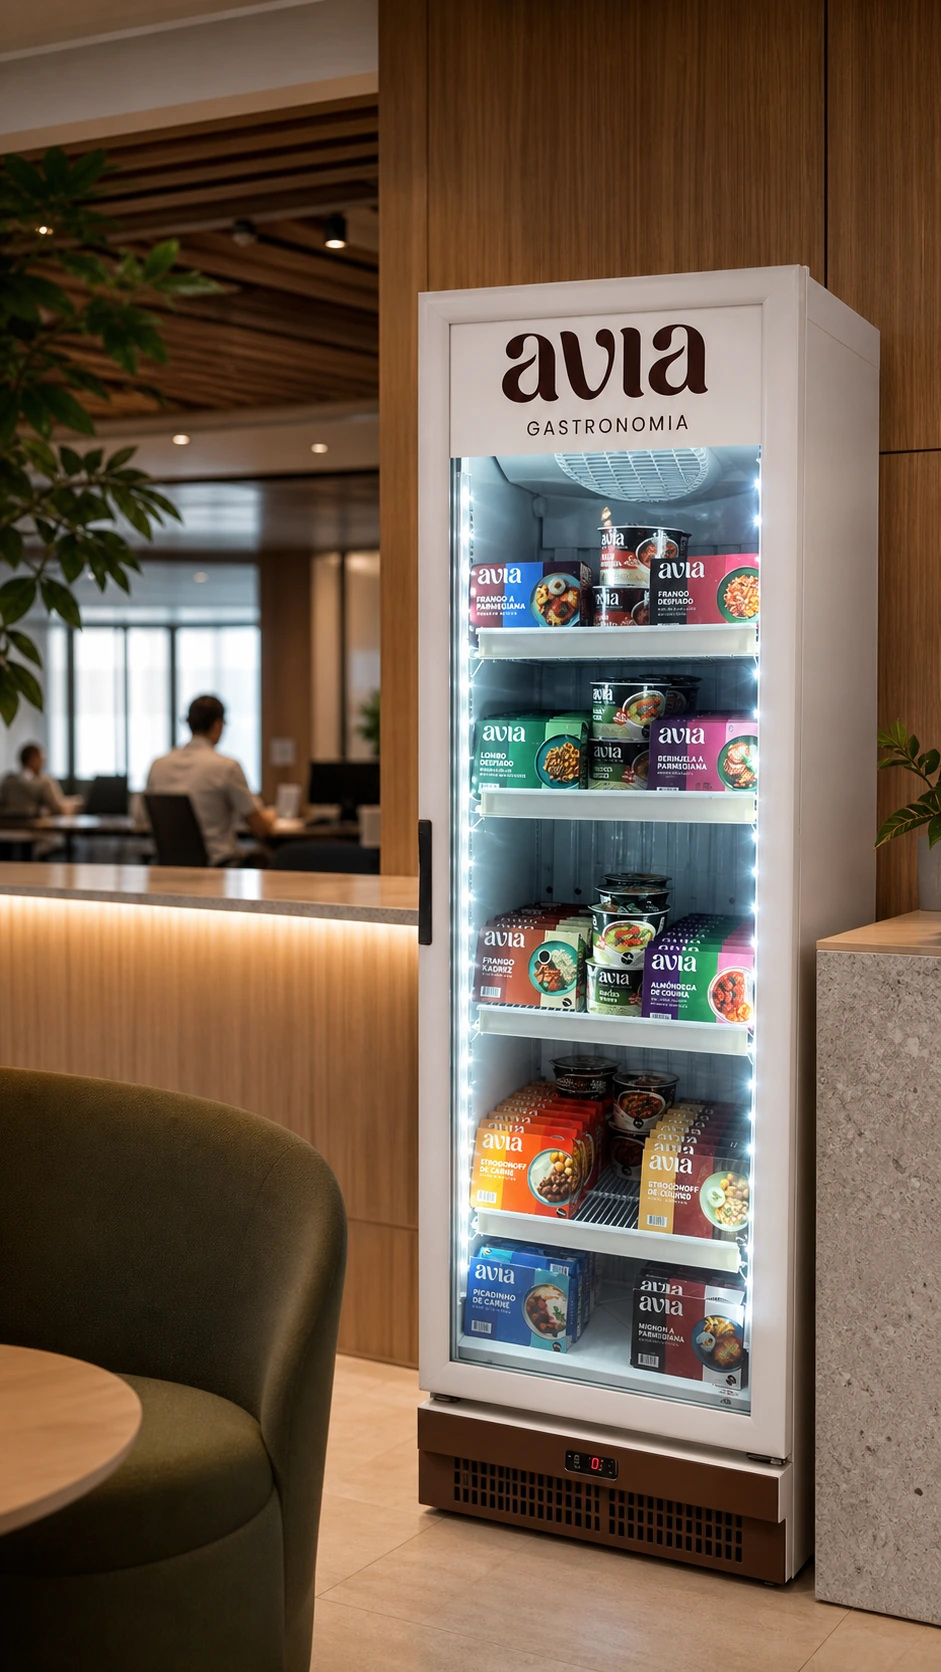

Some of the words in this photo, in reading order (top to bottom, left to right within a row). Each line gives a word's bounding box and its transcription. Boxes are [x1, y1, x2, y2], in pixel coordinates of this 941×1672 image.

[501, 324, 708, 403] avia
[527, 415, 689, 436] GASTRONOMIA
[477, 567, 522, 584] avia
[658, 561, 705, 579] avia
[482, 725, 526, 742] avia
[658, 726, 705, 745] avia
[594, 744, 622, 759] avia
[484, 930, 525, 948] avia
[651, 953, 697, 972] avia
[599, 971, 630, 986] avia
[482, 1133, 523, 1152] avia
[648, 1154, 693, 1175] avia
[474, 1264, 515, 1285] avia
[638, 1295, 683, 1317] avia
